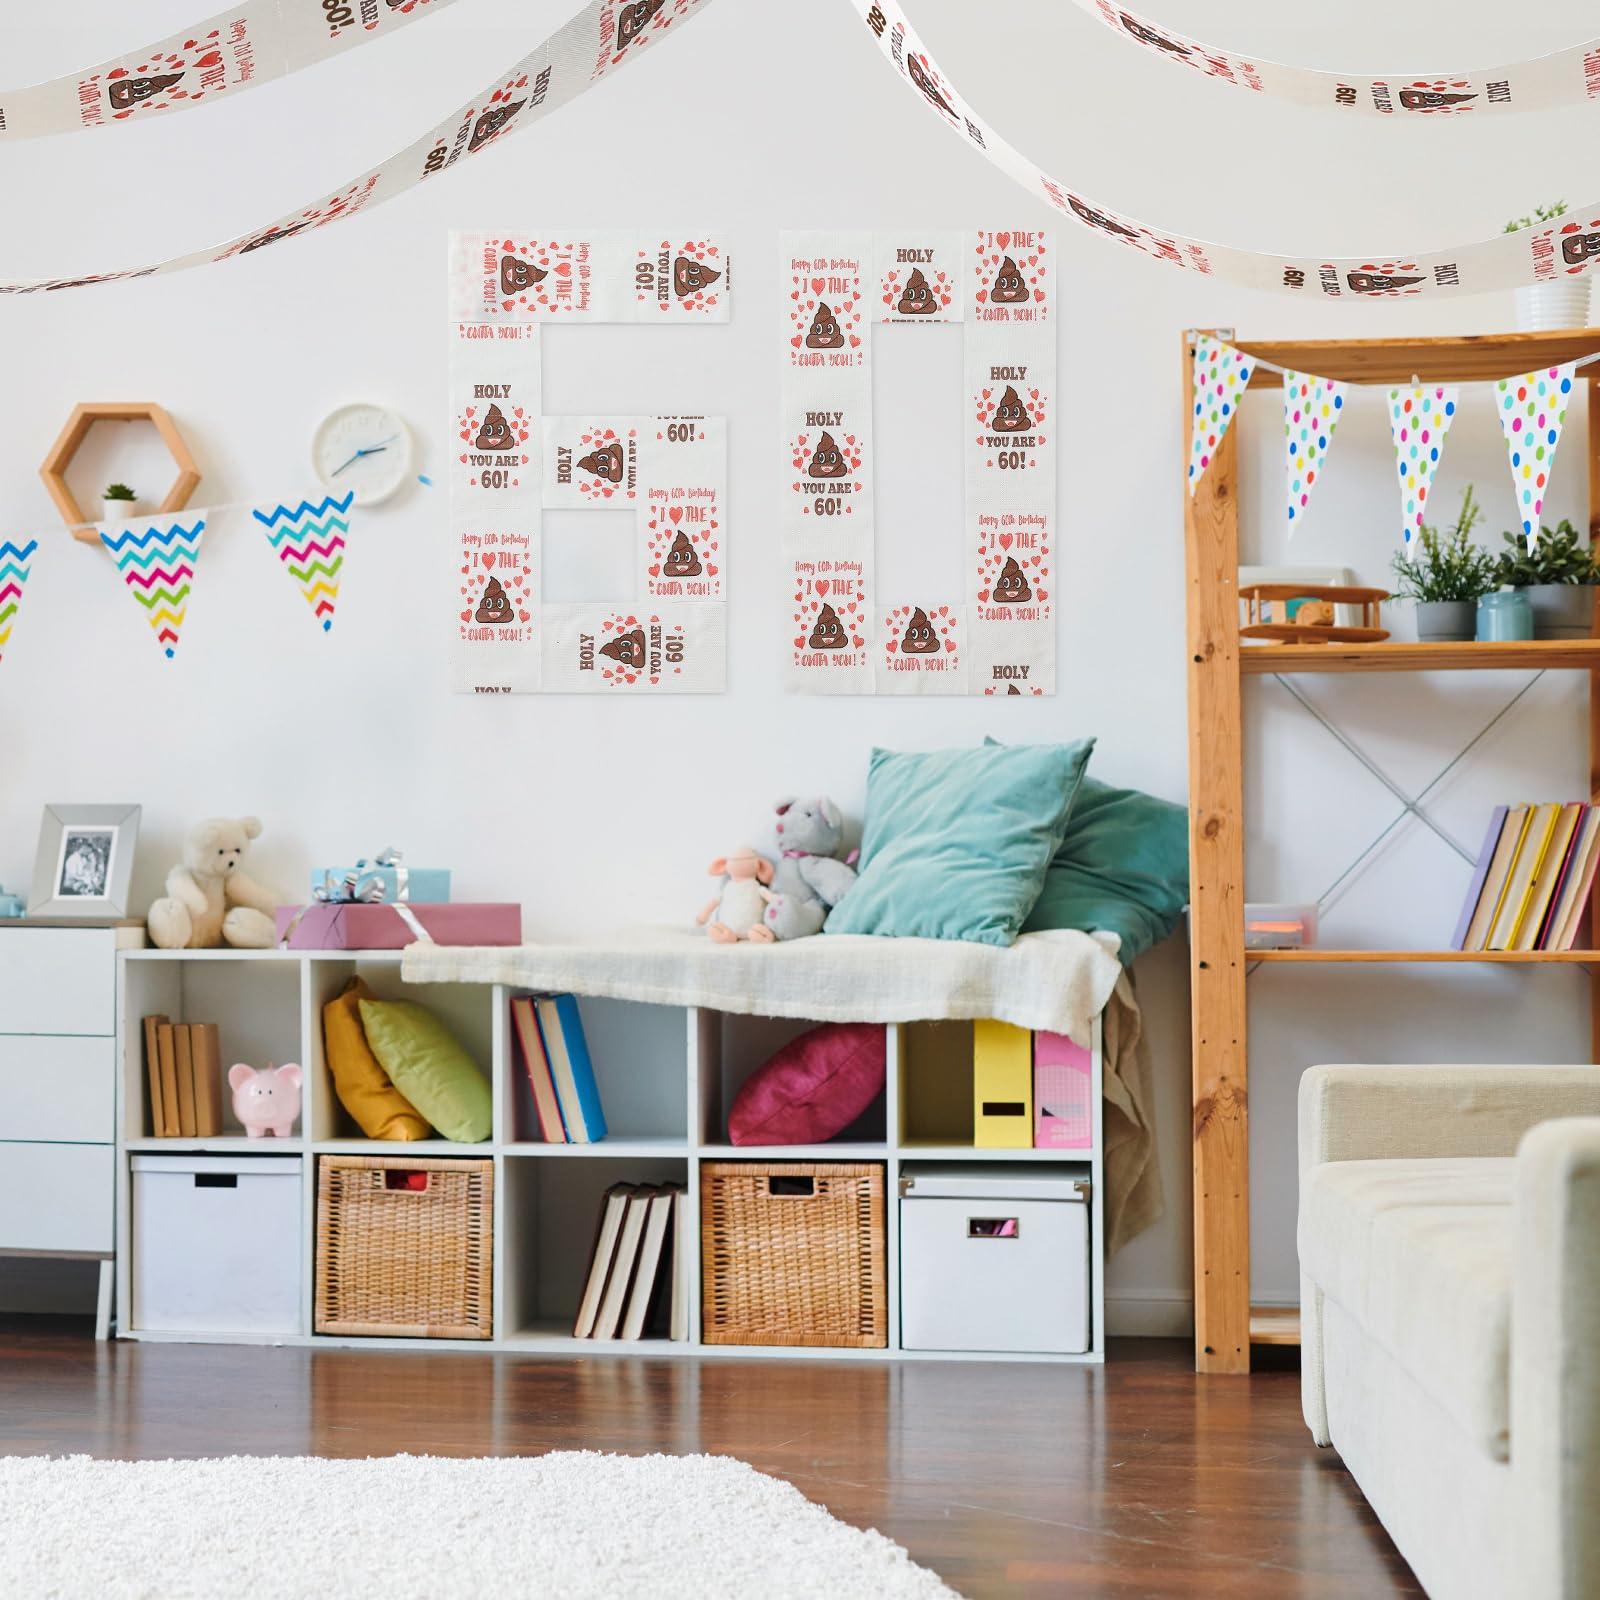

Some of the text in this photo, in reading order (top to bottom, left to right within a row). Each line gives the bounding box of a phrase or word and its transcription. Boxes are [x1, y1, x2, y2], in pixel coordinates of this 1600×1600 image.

[867, 6, 887, 38] 60!
[200, 64, 225, 89] THE
[529, 65, 552, 110] HOLY
[1335, 88, 1357, 104] 60!
[1486, 80, 1512, 103] HOLY
[455, 118, 472, 148] YOU
[423, 146, 448, 176] 60!
[988, 231, 1035, 248] I THE
[576, 242, 591, 263] Happy
[896, 249, 935, 263] HOLY
[791, 258, 811, 274] Happy
[1433, 263, 1460, 286] HOLY
[635, 262, 654, 291] 60!
[658, 250, 669, 301] YOU ARE
[1282, 270, 1305, 287] 60!
[556, 278, 573, 302] THE
[802, 277, 850, 294] I THE
[990, 366, 1027, 381] HOLY
[474, 384, 512, 399] HOLY
[806, 411, 843, 427] HOLY
[667, 423, 695, 443] 60!
[986, 436, 1036, 448] YOU ARE
[469, 454, 519, 467] YOU ARE
[557, 446, 573, 484] HOLY
[998, 451, 1026, 470] 60!
[481, 470, 509, 489] 60!
[802, 482, 852, 494] YOU ARE
[648, 487, 669, 502] Happy
[660, 506, 708, 523] I THE
[814, 497, 842, 516] 60!
[461, 533, 482, 549] Happy
[990, 533, 1039, 549] I THE
[473, 552, 520, 568] I THE
[795, 560, 815, 575] Happy
[806, 579, 854, 595] I THE
[579, 633, 595, 671] HOLY
[651, 625, 662, 675] YOU ARE
[665, 634, 684, 663] 60!
[992, 665, 1030, 680] HOLY
